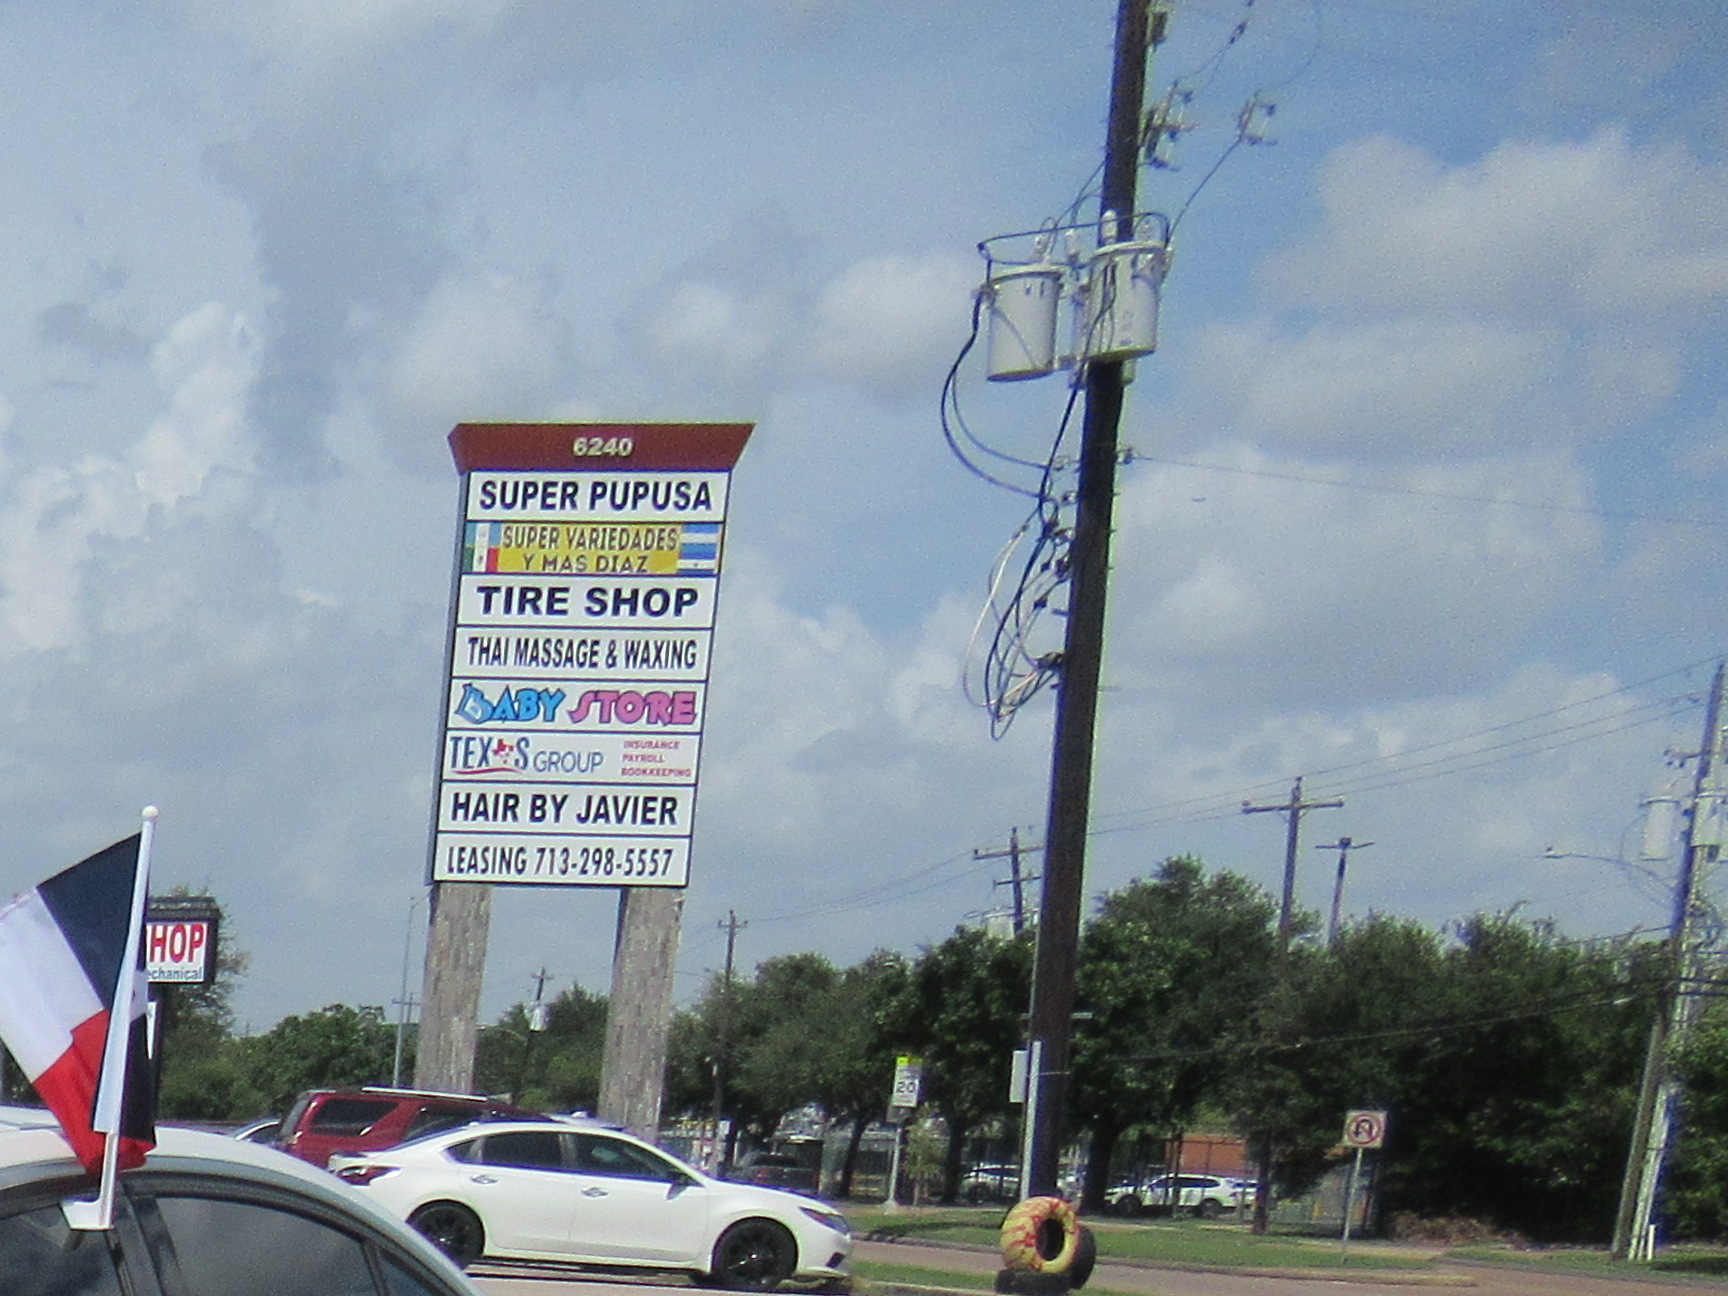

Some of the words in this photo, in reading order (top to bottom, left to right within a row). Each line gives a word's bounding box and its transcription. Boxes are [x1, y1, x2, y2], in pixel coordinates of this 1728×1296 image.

[572, 436, 633, 458] 6240
[478, 480, 579, 511] SUPER
[589, 481, 712, 513] PUPUSA
[501, 526, 561, 550] SUPER
[566, 526, 679, 552] VARIEDADES
[522, 553, 536, 571] Y
[543, 554, 589, 573] MAS
[595, 555, 649, 574] DIAZ
[476, 586, 571, 616] TIRE
[584, 587, 699, 618] SHOP
[468, 636, 509, 667] THAI
[513, 637, 601, 669] MASSAGE
[604, 640, 617, 669] &
[624, 639, 698, 670] WAXING
[454, 682, 567, 725] BABY
[567, 689, 698, 727] STORE
[532, 750, 605, 774] GROUP
[450, 792, 520, 822] HAIR
[528, 793, 569, 824] BY
[575, 795, 679, 826] JAVIER
[446, 846, 528, 875] LEASING
[533, 847, 674, 879] 713-298-5557
[148, 923, 204, 963] HOP
[145, 966, 204, 980] echanical
[896, 1081, 917, 1093] 20
